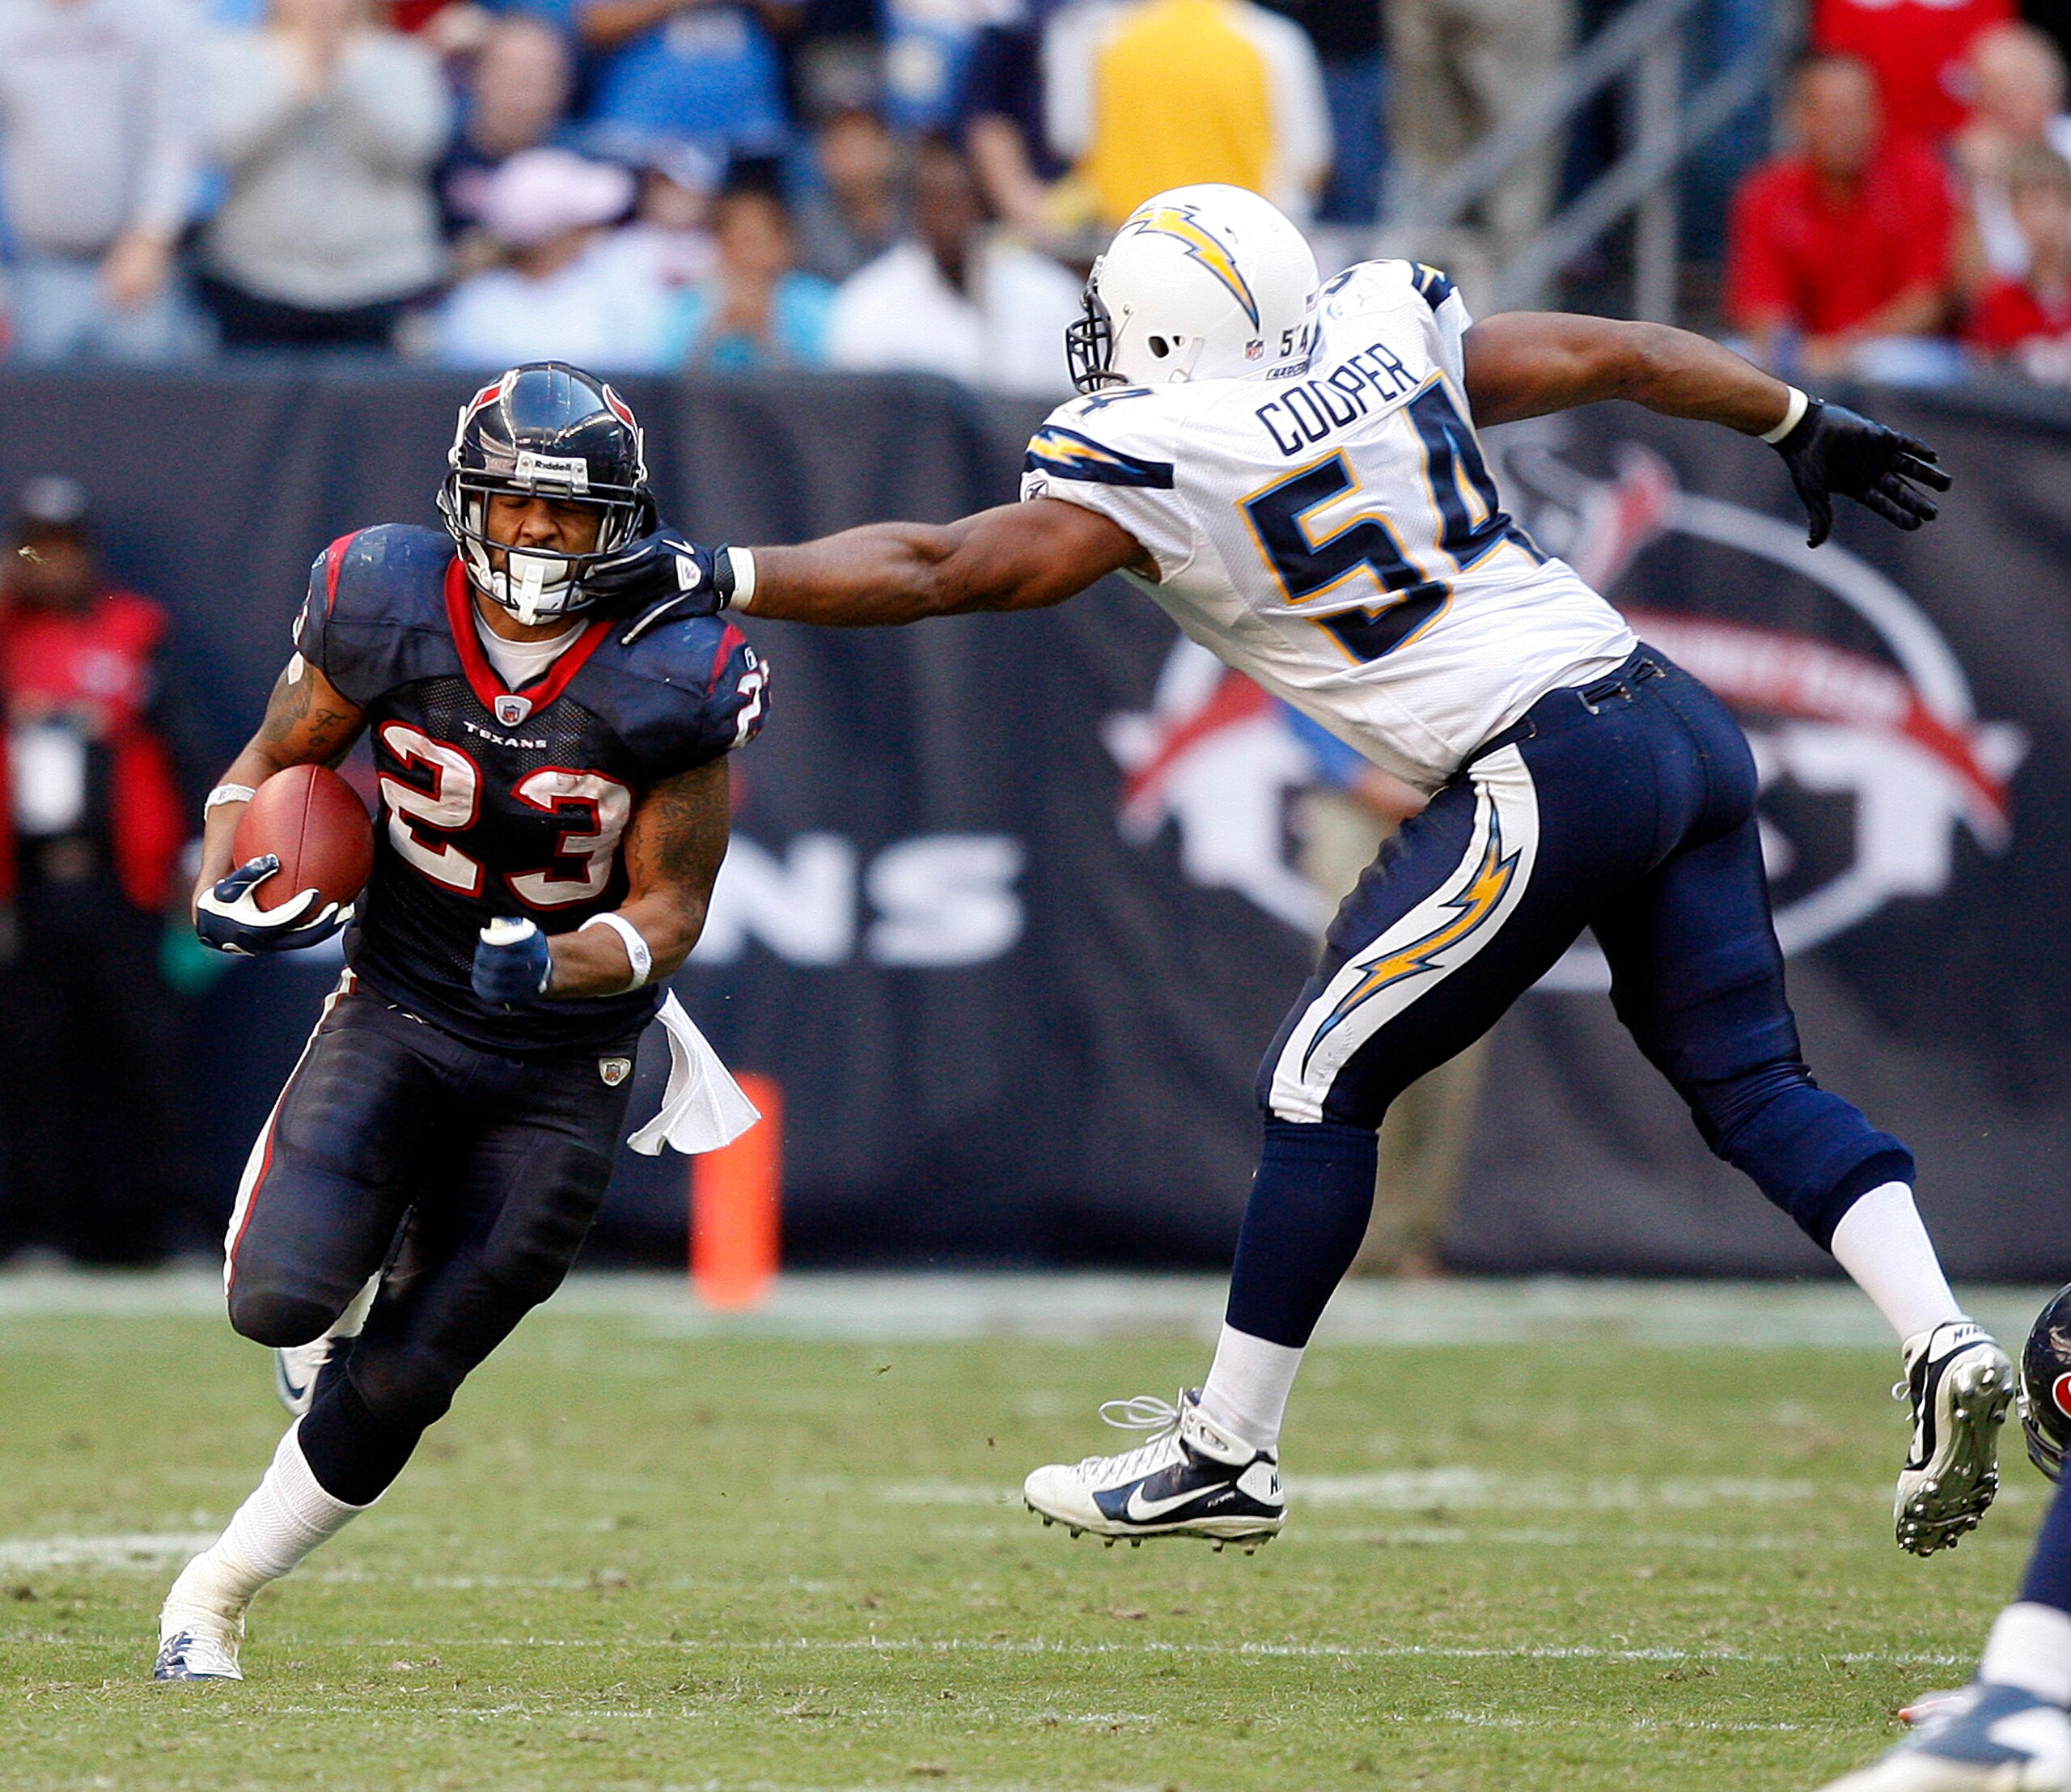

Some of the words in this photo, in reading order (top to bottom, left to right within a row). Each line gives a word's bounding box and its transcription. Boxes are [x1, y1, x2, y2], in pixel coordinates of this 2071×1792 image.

[1279, 323, 1310, 358] 54
[1256, 343, 1421, 457] COOPER
[534, 460, 572, 472] Riddell
[1235, 369, 1549, 666] 54
[463, 720, 548, 748] TEXANS
[377, 718, 636, 912] 23
